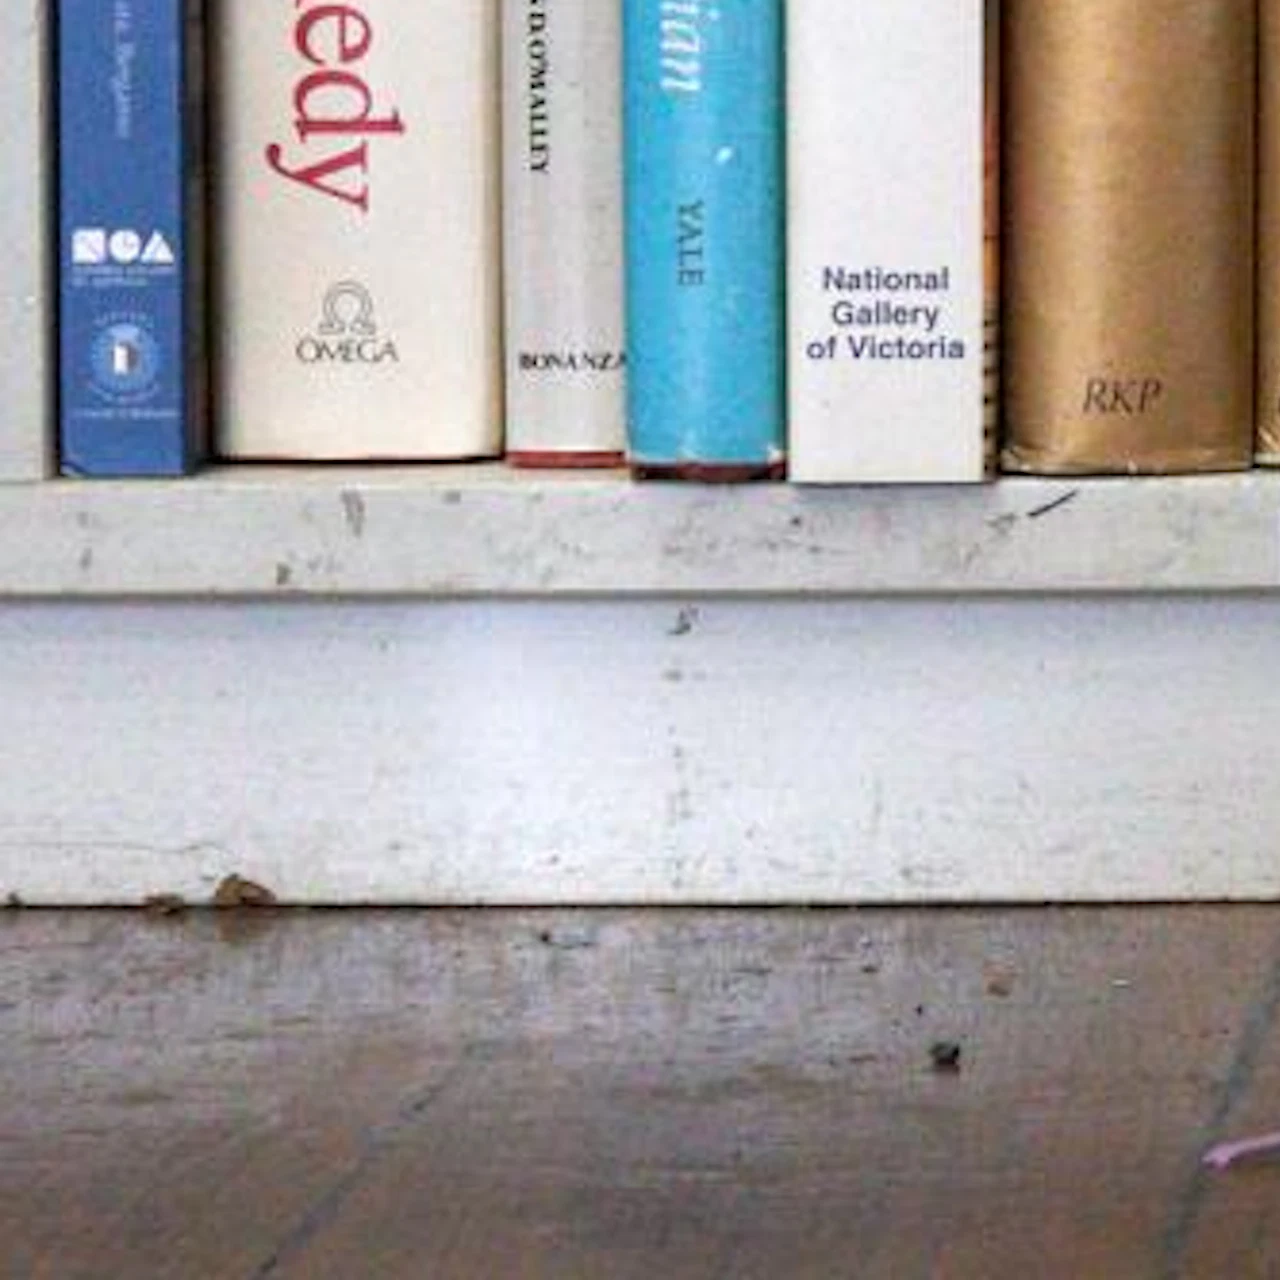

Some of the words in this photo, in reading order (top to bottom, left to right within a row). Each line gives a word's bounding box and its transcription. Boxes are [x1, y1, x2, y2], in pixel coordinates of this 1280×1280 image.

[676, 199, 706, 287] YALE
[823, 267, 950, 292] National
[832, 300, 940, 328] Gallery
[296, 340, 399, 363] OMEGA
[807, 336, 836, 361] of
[847, 336, 966, 361] Victoria
[1082, 377, 1163, 414] RKP
